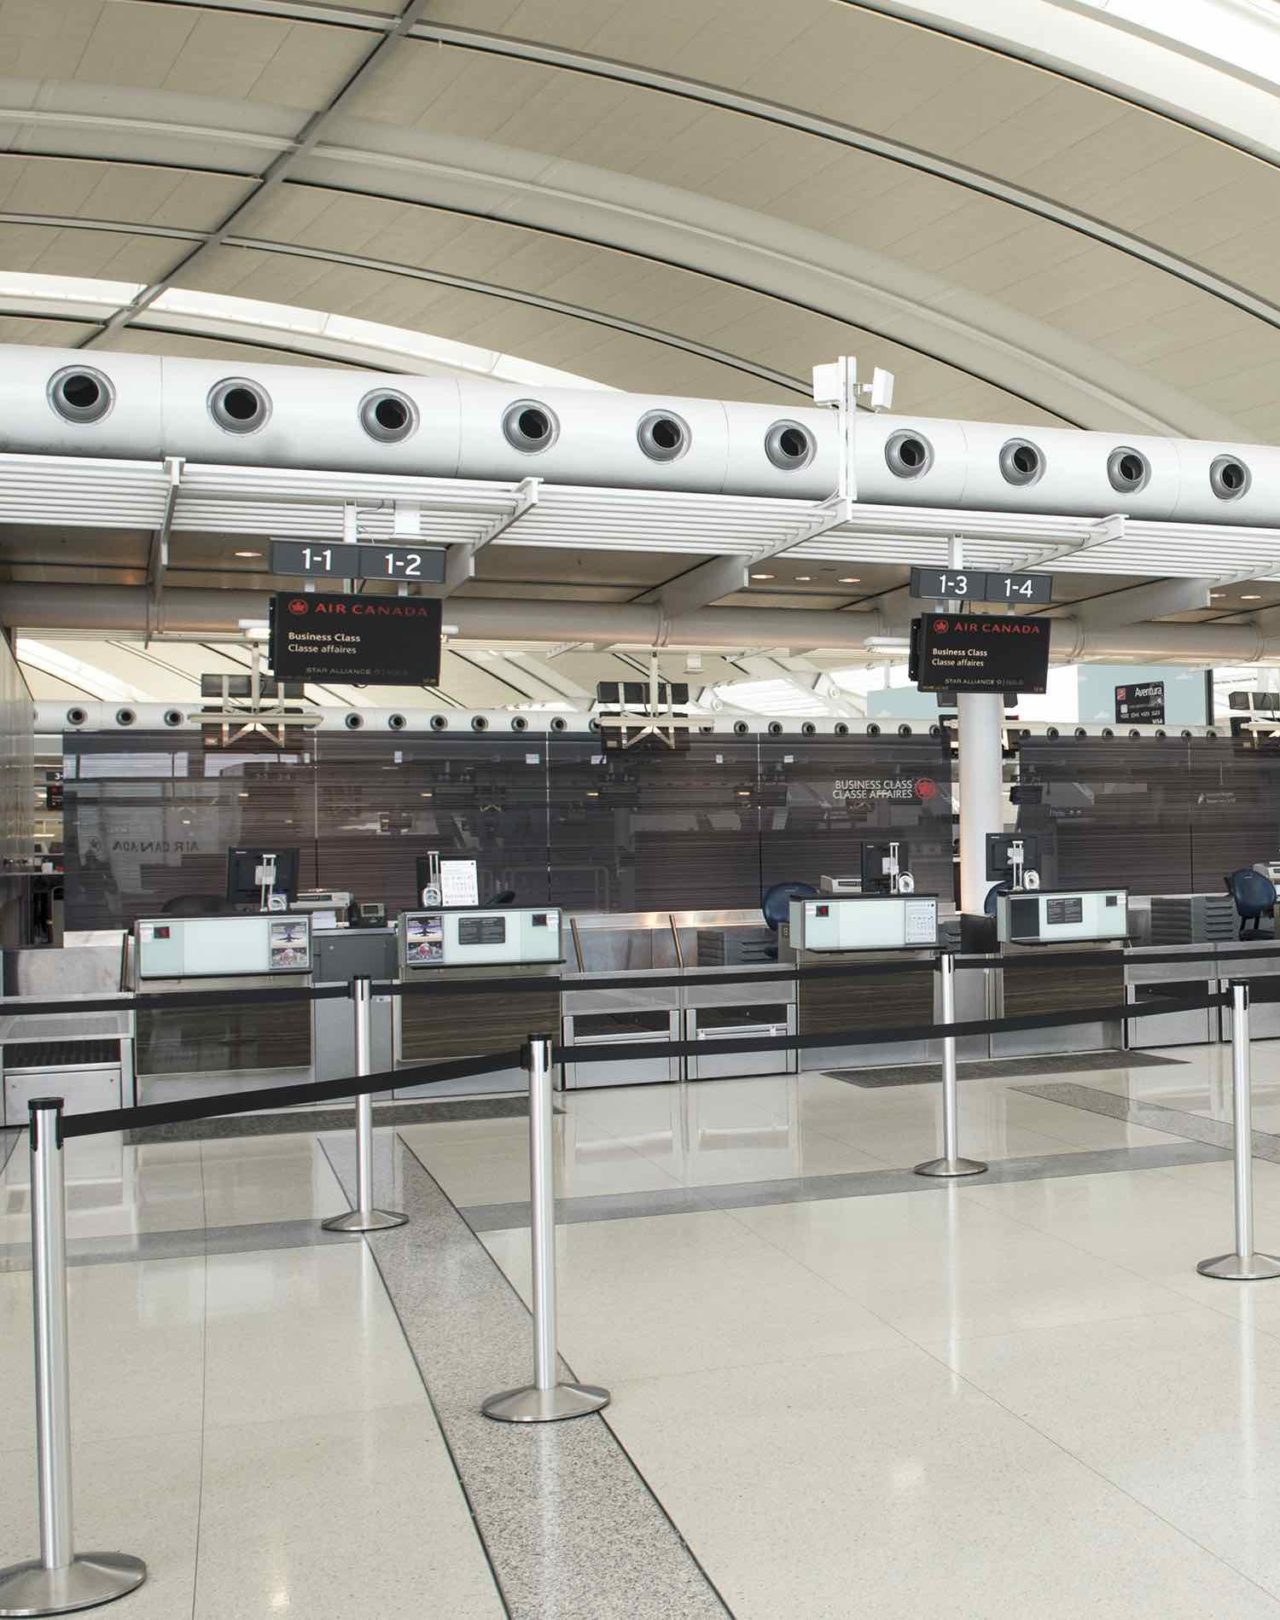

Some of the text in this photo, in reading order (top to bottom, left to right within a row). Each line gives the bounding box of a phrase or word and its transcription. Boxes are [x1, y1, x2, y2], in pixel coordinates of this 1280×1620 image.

[302, 548, 332, 571] 1-1
[385, 553, 422, 576] 1-2
[939, 574, 968, 594] 1-3
[1004, 578, 1033, 598] 1-4
[315, 603, 429, 617] AIR CANADA
[954, 622, 1040, 634] AIR CANADA
[288, 632, 361, 642] Business Class
[288, 644, 357, 654] Classe affaires
[932, 647, 988, 657] Business Class
[931, 657, 984, 667] Classe affaires
[306, 666, 328, 674] STAR
[1134, 686, 1163, 697] Aventura
[835, 780, 913, 790] BUSINESS CLASS
[832, 790, 913, 799] CLASSE AFFAIRES
